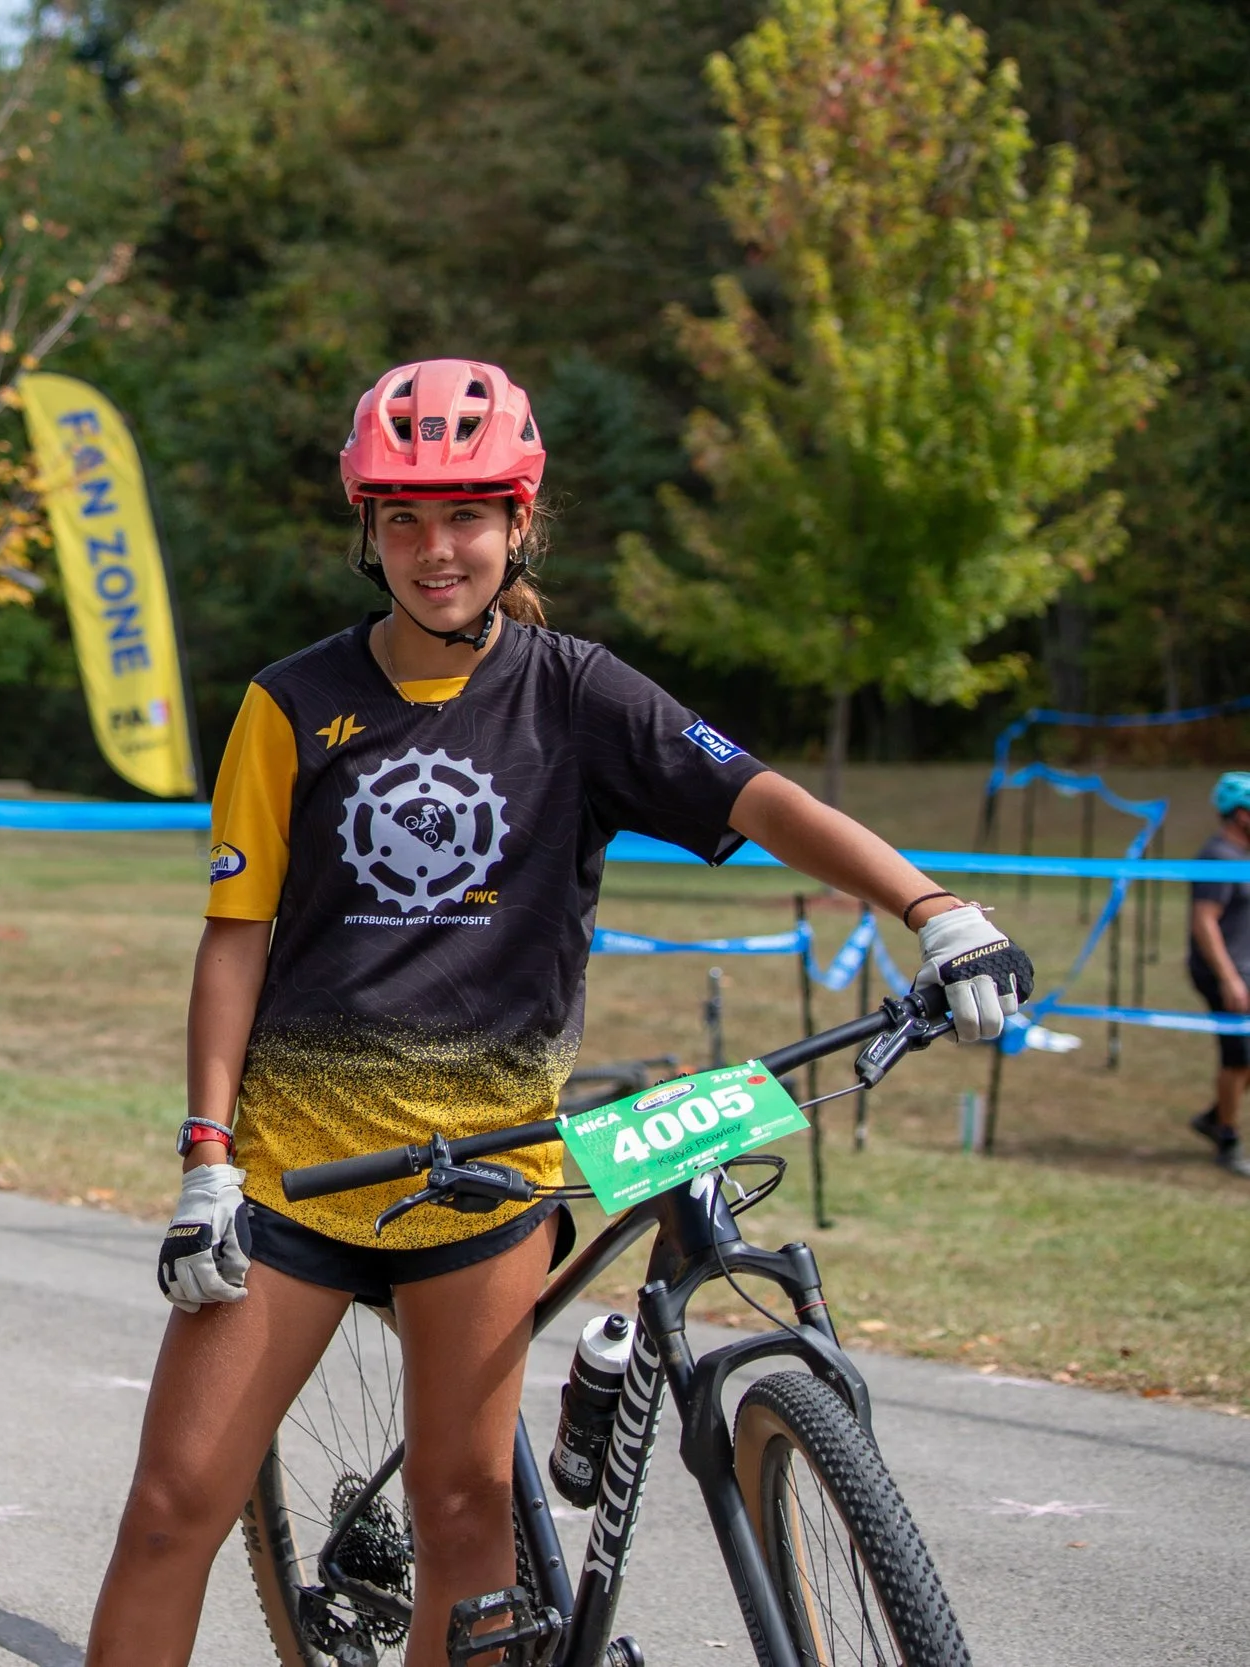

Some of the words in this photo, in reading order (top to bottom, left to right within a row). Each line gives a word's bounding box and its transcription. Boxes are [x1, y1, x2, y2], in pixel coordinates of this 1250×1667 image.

[56, 408, 118, 518] FAN
[86, 530, 153, 677] ZONE
[694, 724, 732, 757] NICA
[464, 890, 499, 904] PWC
[344, 915, 403, 926] PITTSBURGH
[405, 915, 431, 926] WEST
[433, 915, 491, 926] COMPOSITE
[951, 940, 1010, 968] SPECIALIZED
[710, 1068, 753, 1083] 2025
[643, 1086, 686, 1107] PENNSYLVANIA
[574, 1112, 623, 1137] NICA
[612, 1084, 755, 1165] 4005
[657, 1145, 693, 1166] Katya
[695, 1123, 741, 1148] Rowley
[674, 1141, 729, 1171] TREK
[584, 1331, 660, 1593] SPECIALIZE
